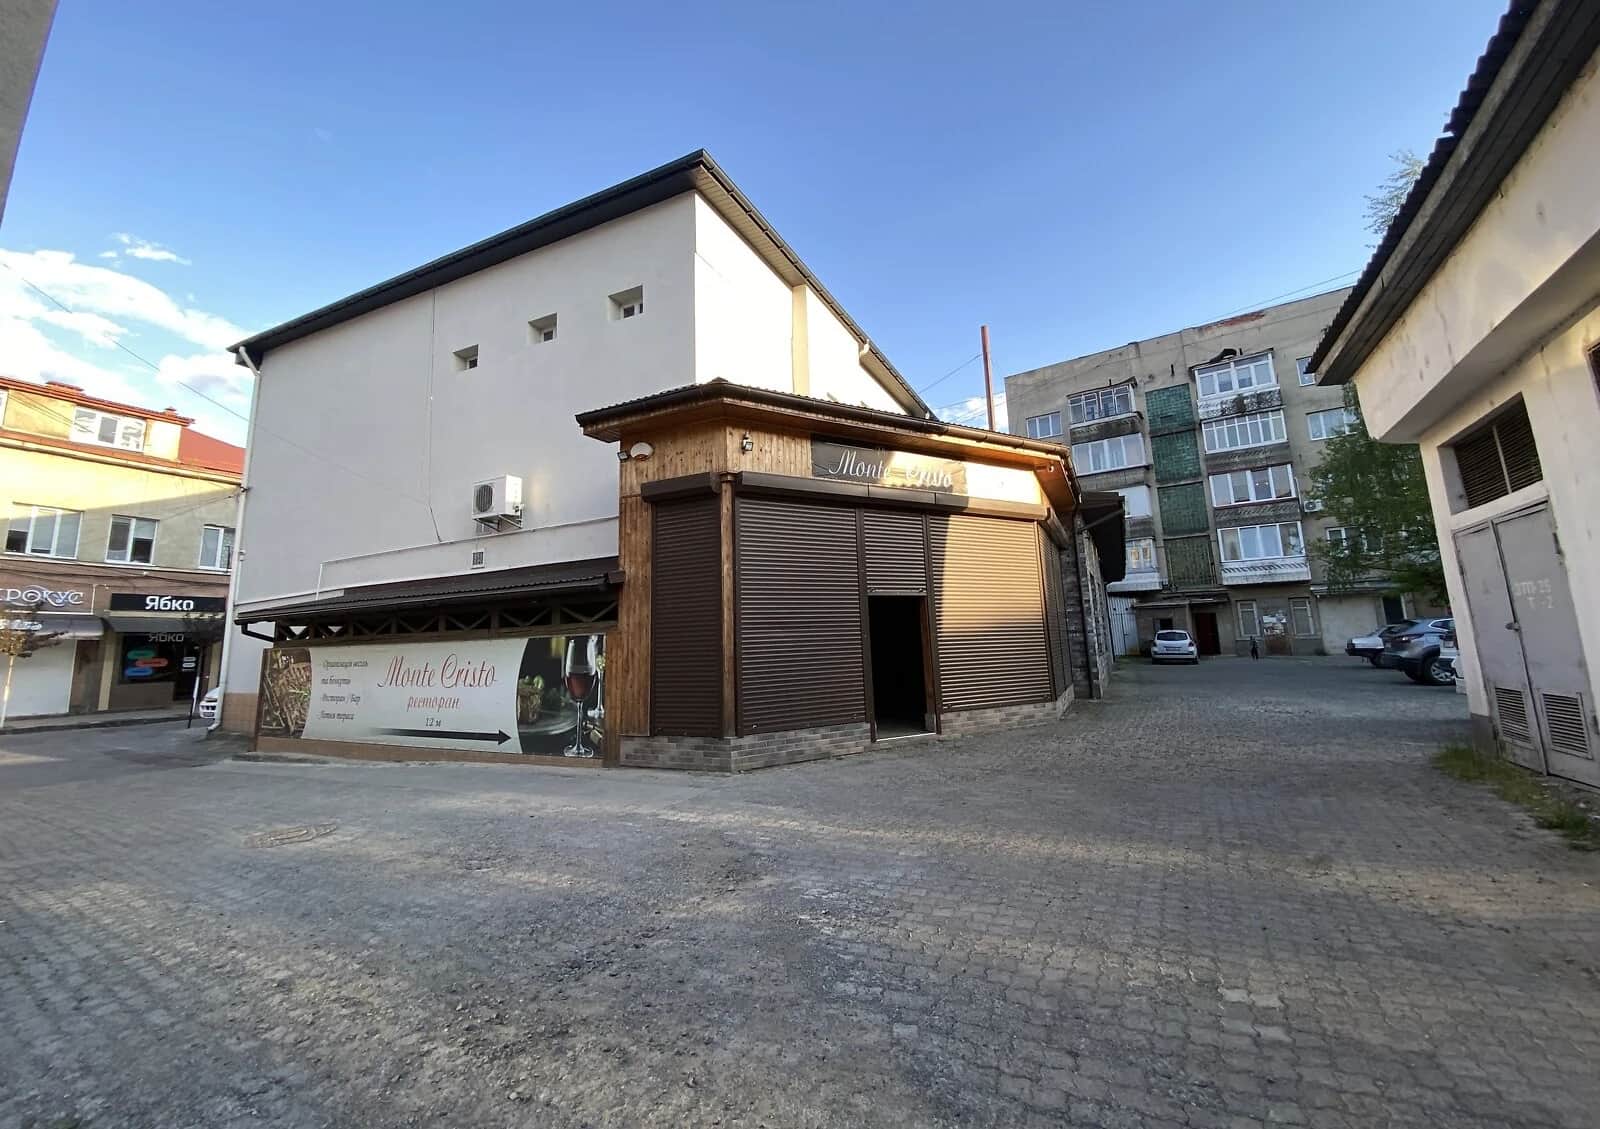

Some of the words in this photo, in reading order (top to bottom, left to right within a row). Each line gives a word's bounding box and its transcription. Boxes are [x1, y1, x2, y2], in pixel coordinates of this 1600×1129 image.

[828, 449, 891, 479] Monte
[145, 595, 194, 611] Ябко
[377, 655, 436, 688] Monte
[441, 653, 497, 689] Cristo
[406, 696, 460, 712] ресторан
[425, 717, 435, 727] 12
